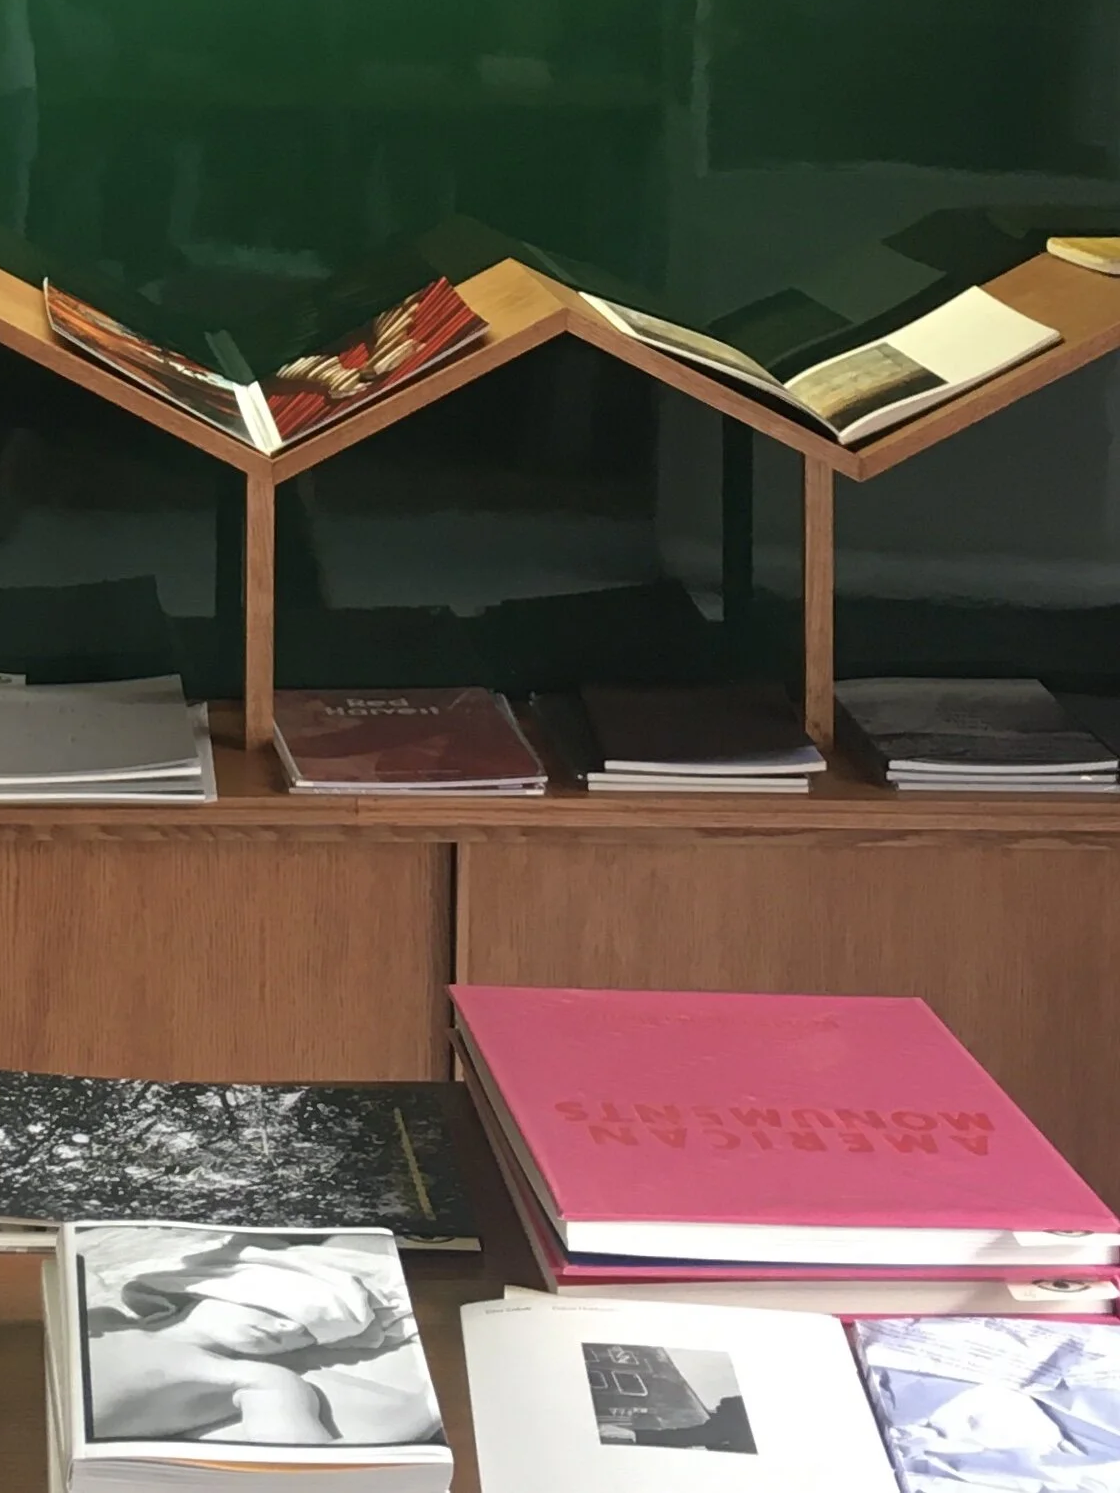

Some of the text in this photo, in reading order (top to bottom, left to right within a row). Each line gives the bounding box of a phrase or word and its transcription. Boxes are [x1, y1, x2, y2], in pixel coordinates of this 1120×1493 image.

[346, 698, 408, 707] Red
[554, 1101, 995, 1133] MONUMENTS
[588, 1124, 990, 1157] AMERICAN
